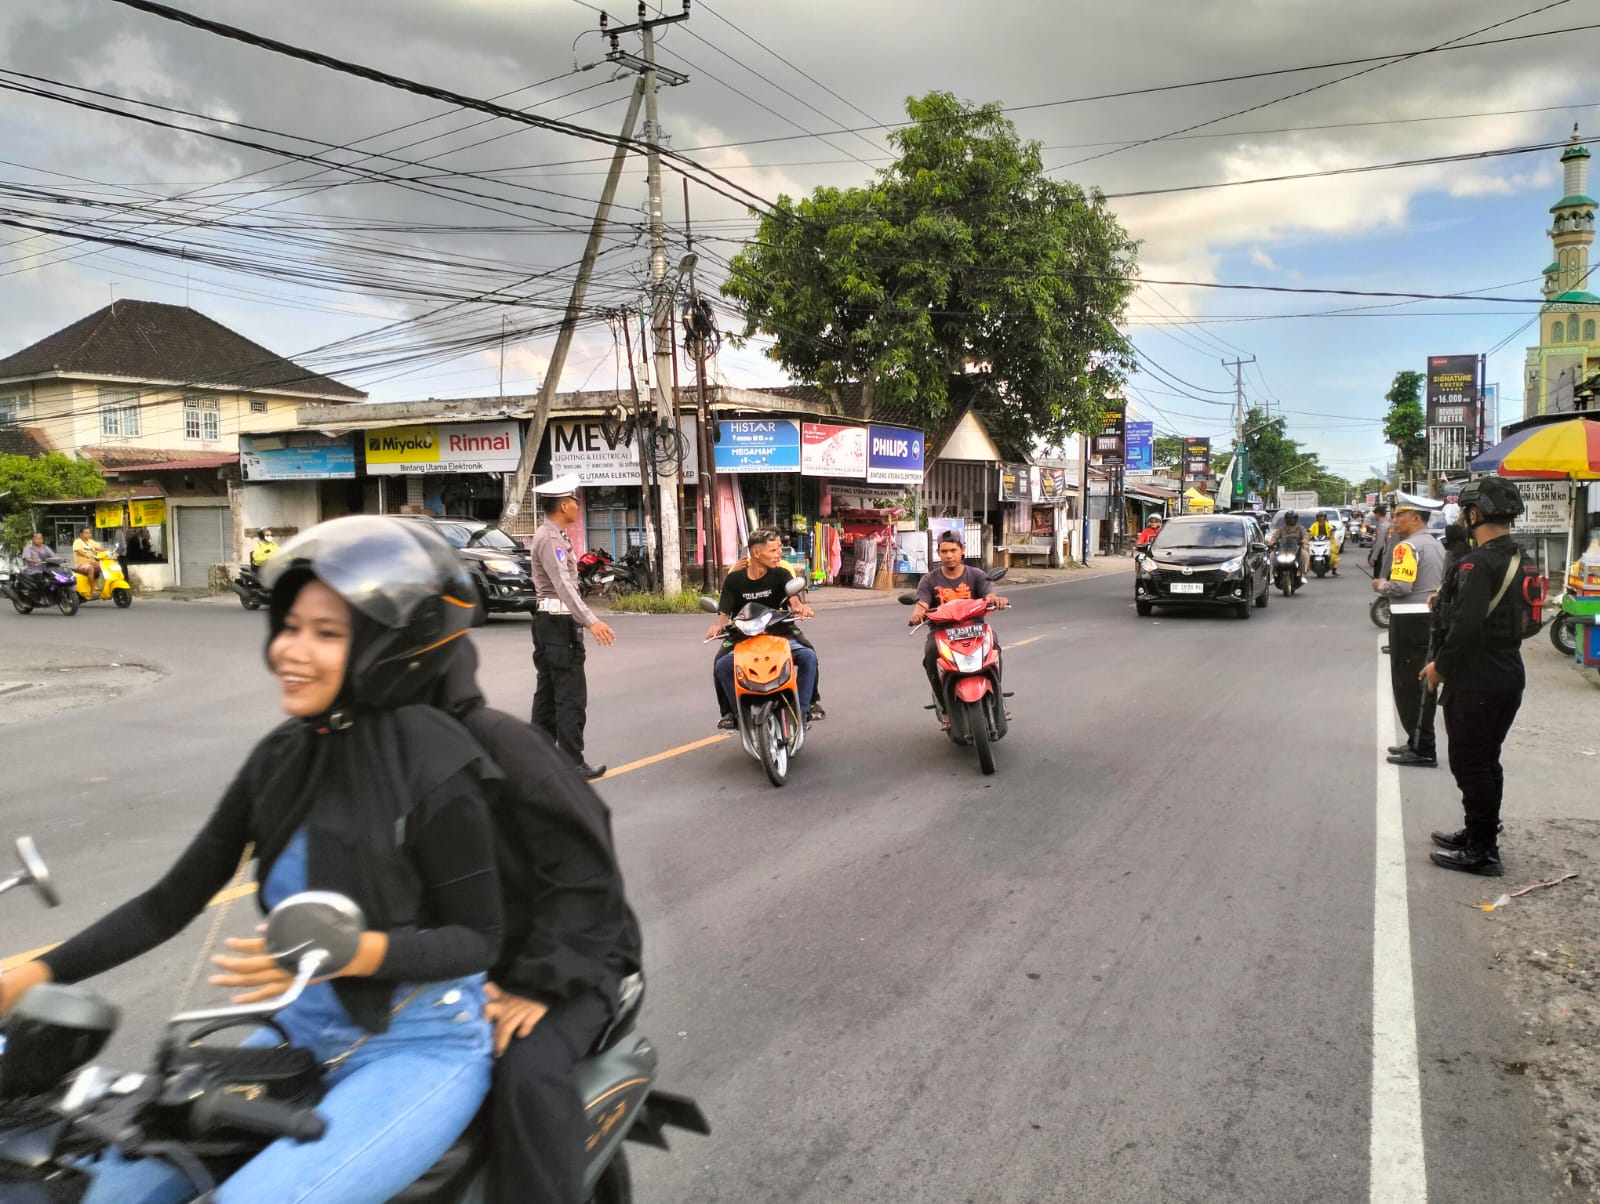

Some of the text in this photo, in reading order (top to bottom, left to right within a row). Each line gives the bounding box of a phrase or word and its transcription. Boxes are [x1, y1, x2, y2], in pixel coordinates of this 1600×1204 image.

[1433, 374, 1472, 383] SIGNATURE
[449, 432, 511, 452] Rinnai
[872, 437, 909, 458] PHILIPS
[555, 454, 585, 462] LIGHTING
[400, 462, 483, 472] Bintang Utama Elektronik
[586, 472, 609, 480] UTAMA
